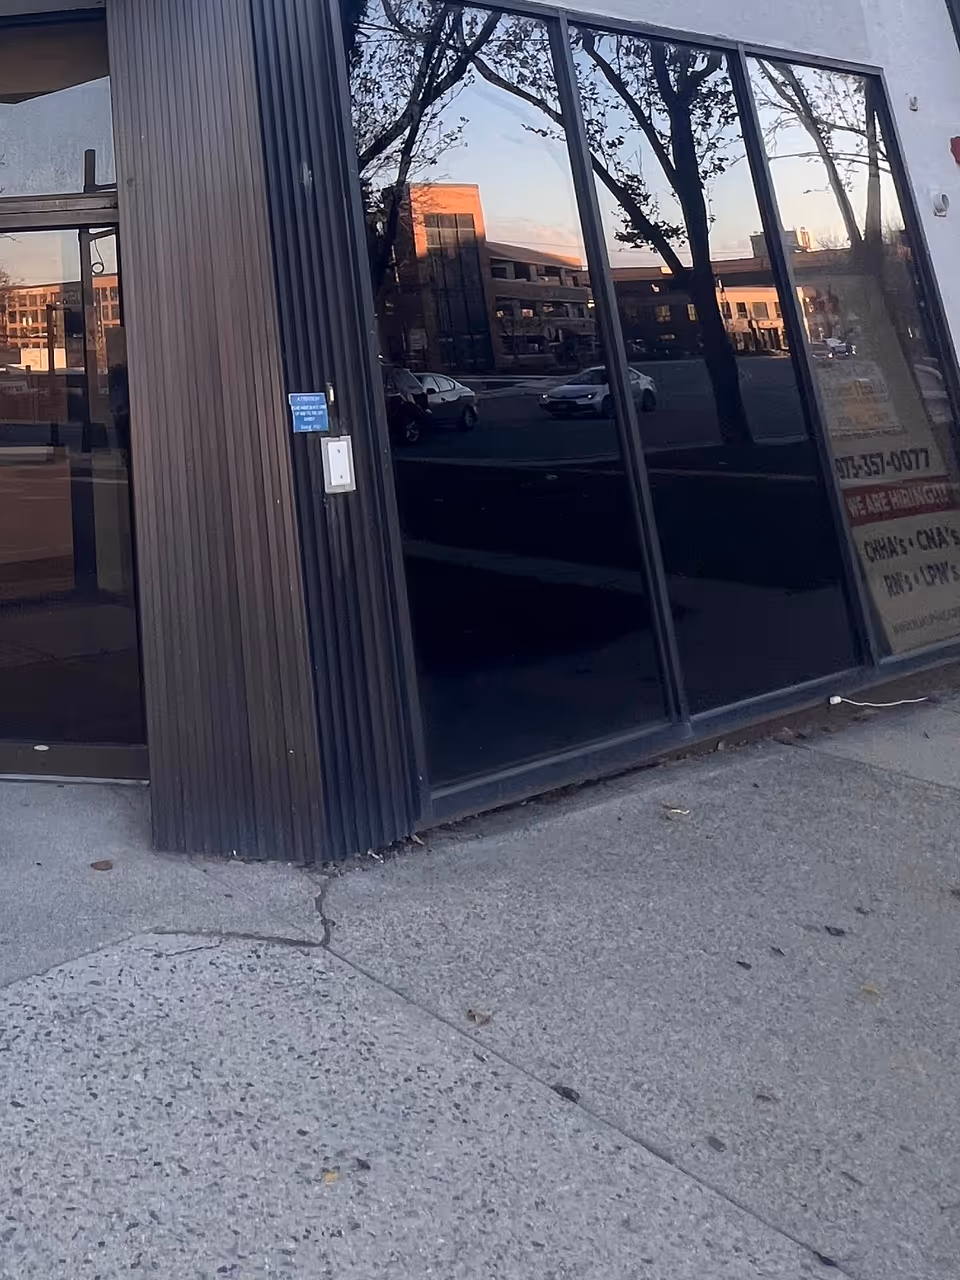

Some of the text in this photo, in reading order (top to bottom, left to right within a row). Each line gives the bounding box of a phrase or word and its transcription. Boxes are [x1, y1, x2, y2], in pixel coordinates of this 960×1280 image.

[835, 447, 930, 480] 973-357-0077
[845, 495, 867, 518] WE
[865, 491, 891, 514] ARE
[863, 525, 960, 563] CHHA's CNA's
[883, 561, 960, 597] RN's LPN's
